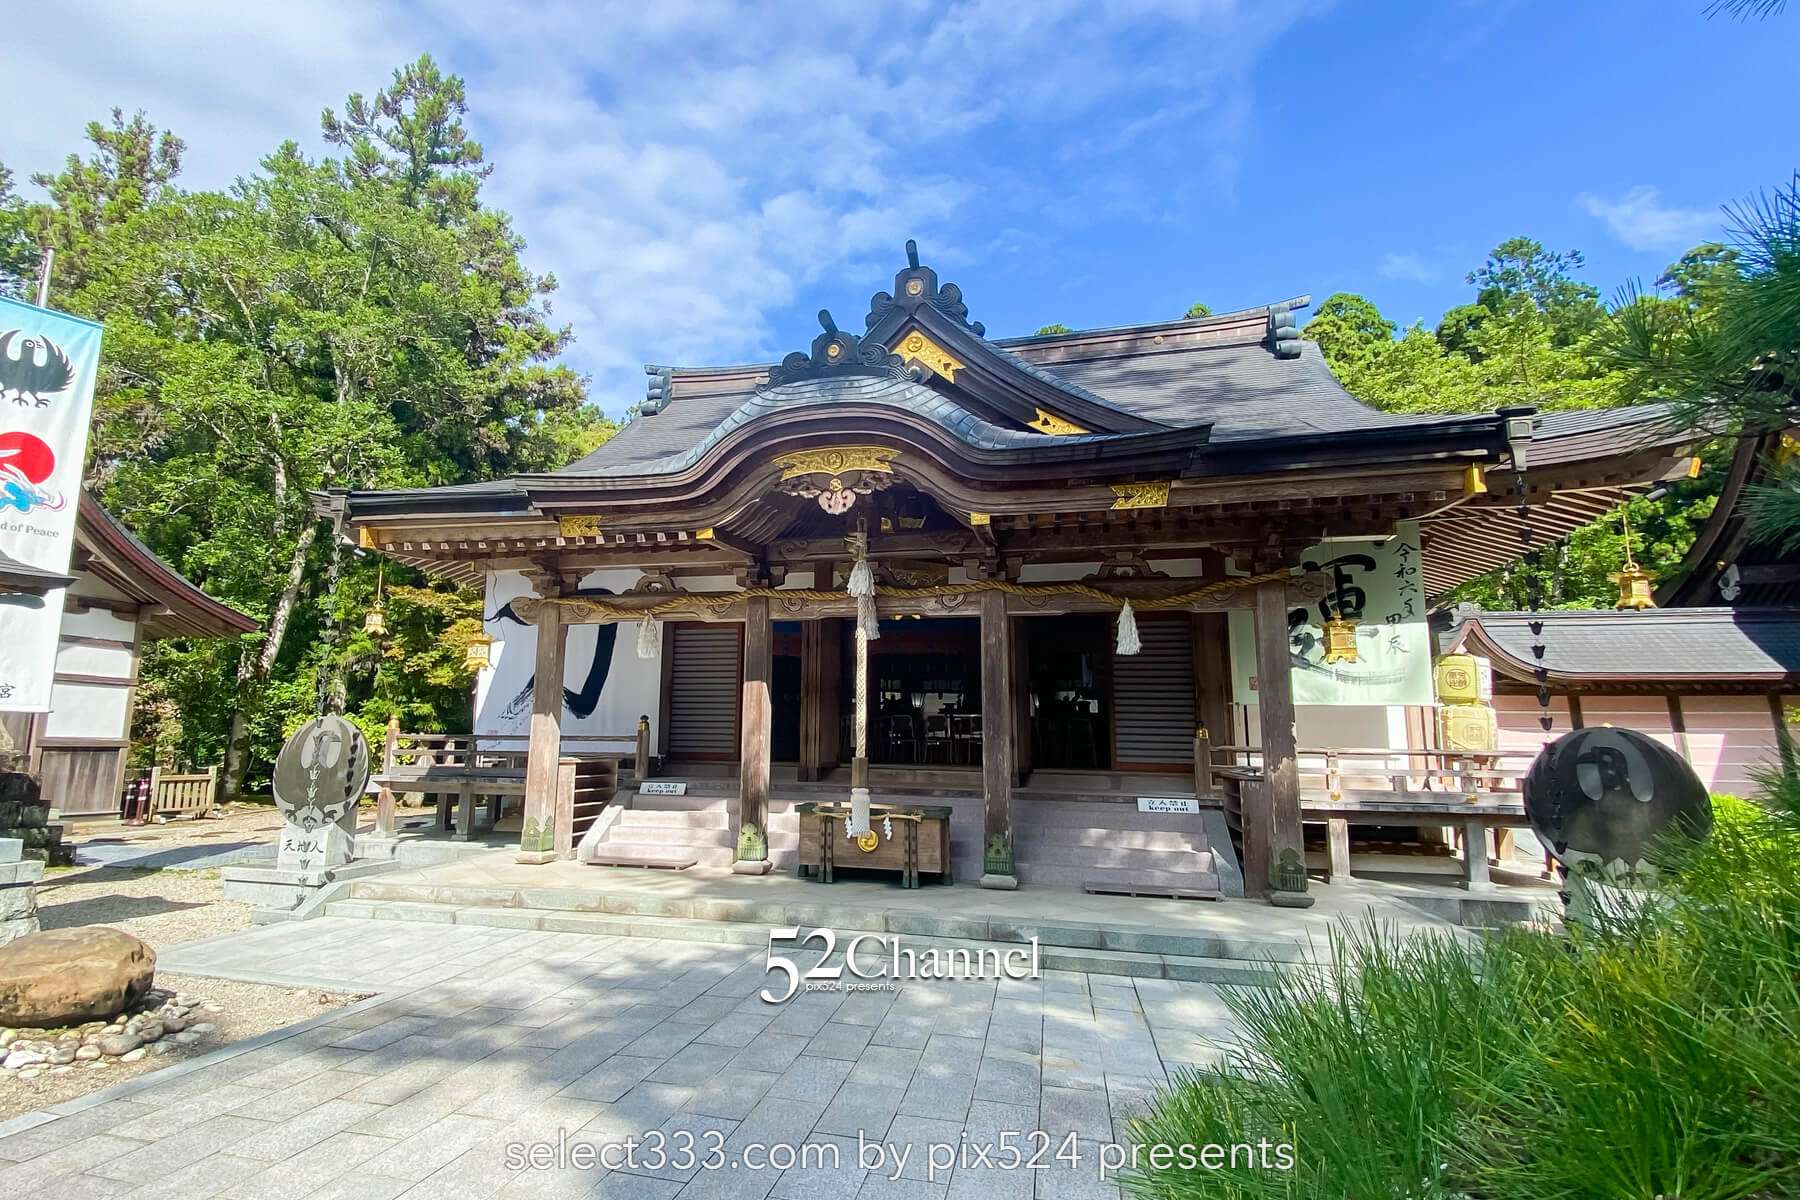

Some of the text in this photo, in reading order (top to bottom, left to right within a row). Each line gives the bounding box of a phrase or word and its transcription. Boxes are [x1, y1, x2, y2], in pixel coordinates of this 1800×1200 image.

[10, 524, 24, 532] of
[25, 524, 60, 537] Peace
[283, 839, 324, 854] 天地人
